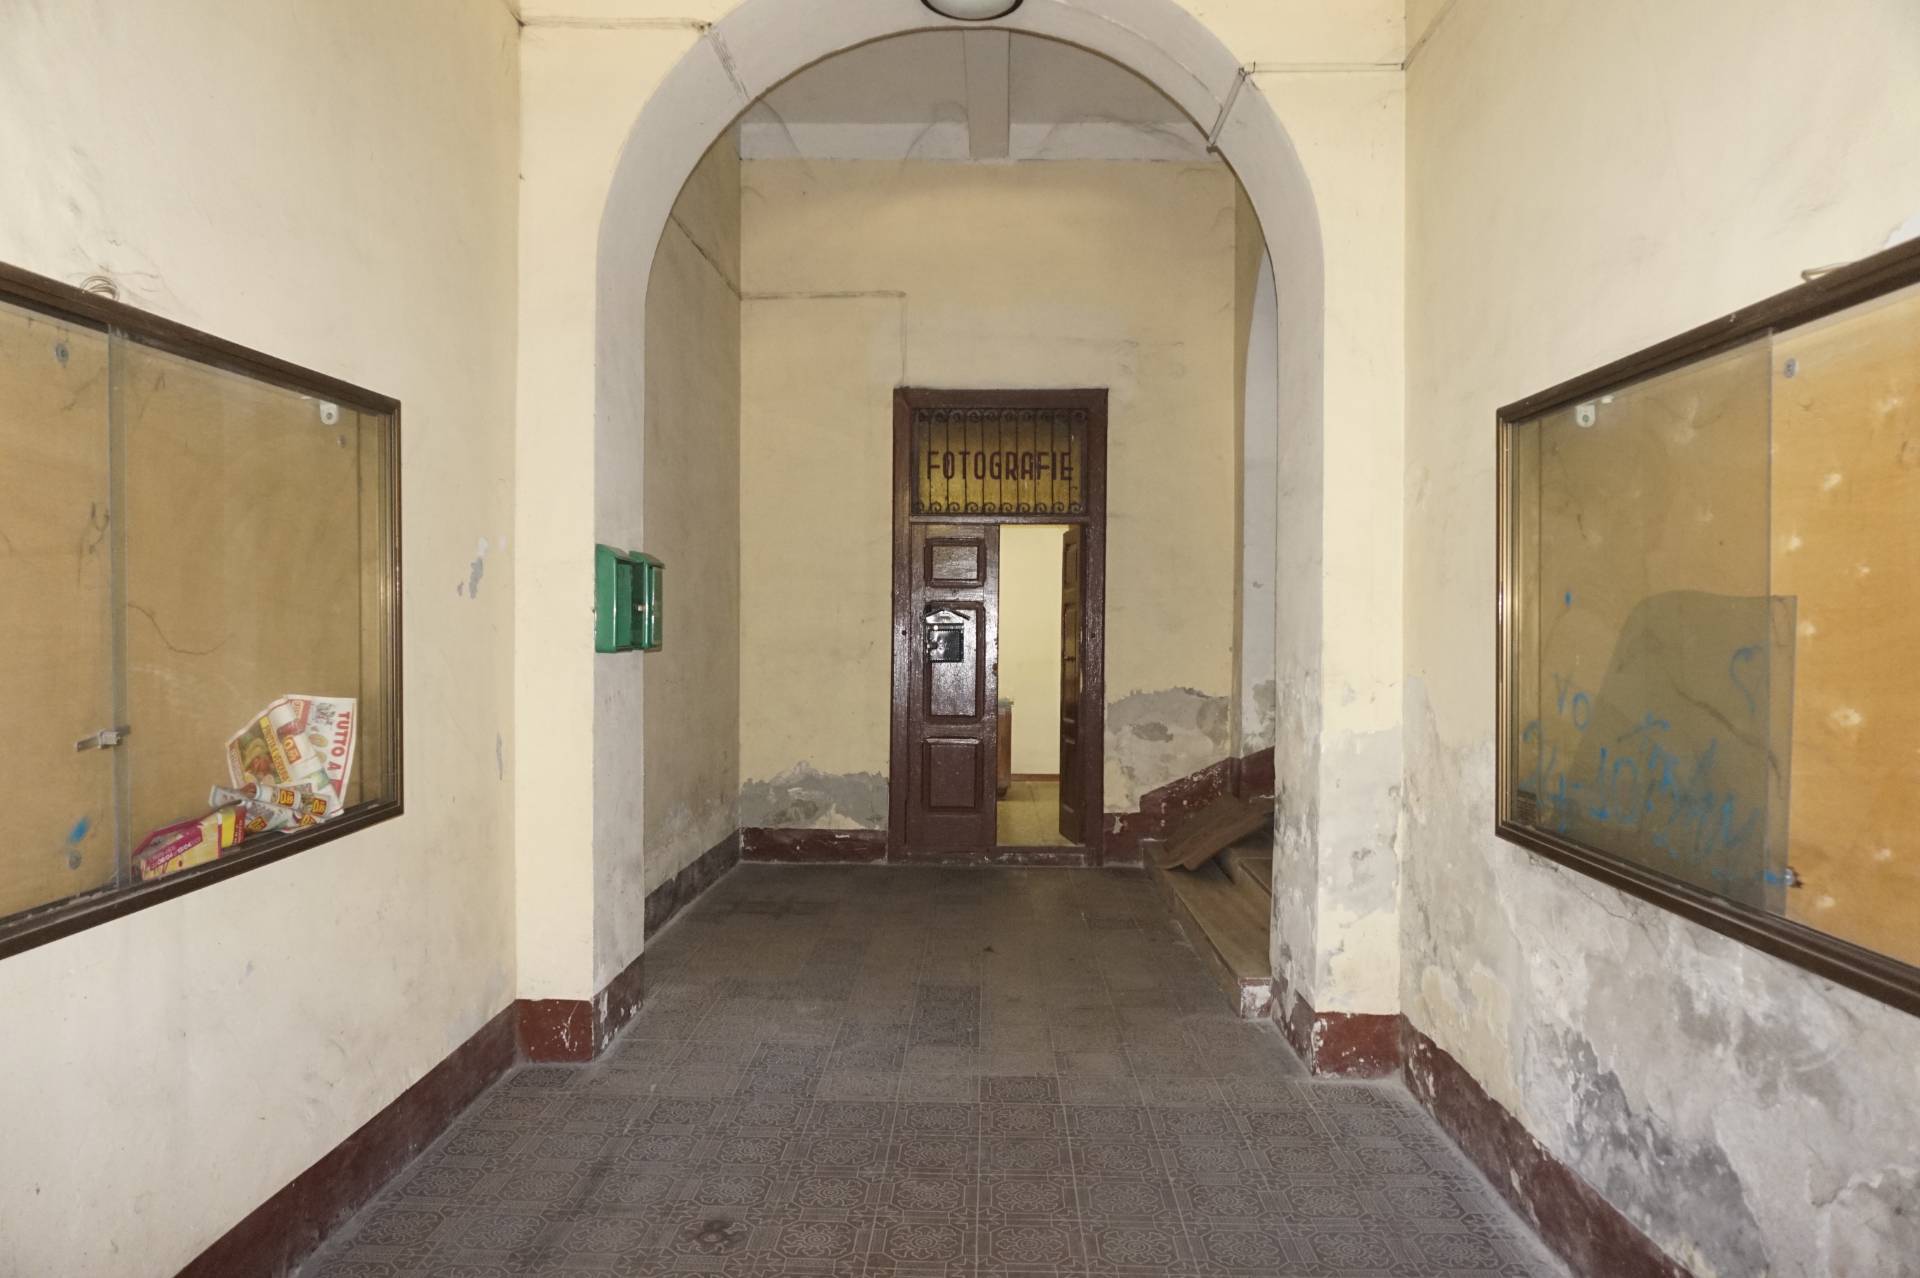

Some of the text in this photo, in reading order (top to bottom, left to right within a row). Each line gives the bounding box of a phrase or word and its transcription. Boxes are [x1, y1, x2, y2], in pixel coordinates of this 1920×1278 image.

[927, 451, 1074, 481] FOTOGRAFIE
[327, 711, 351, 772] TUTTO A
